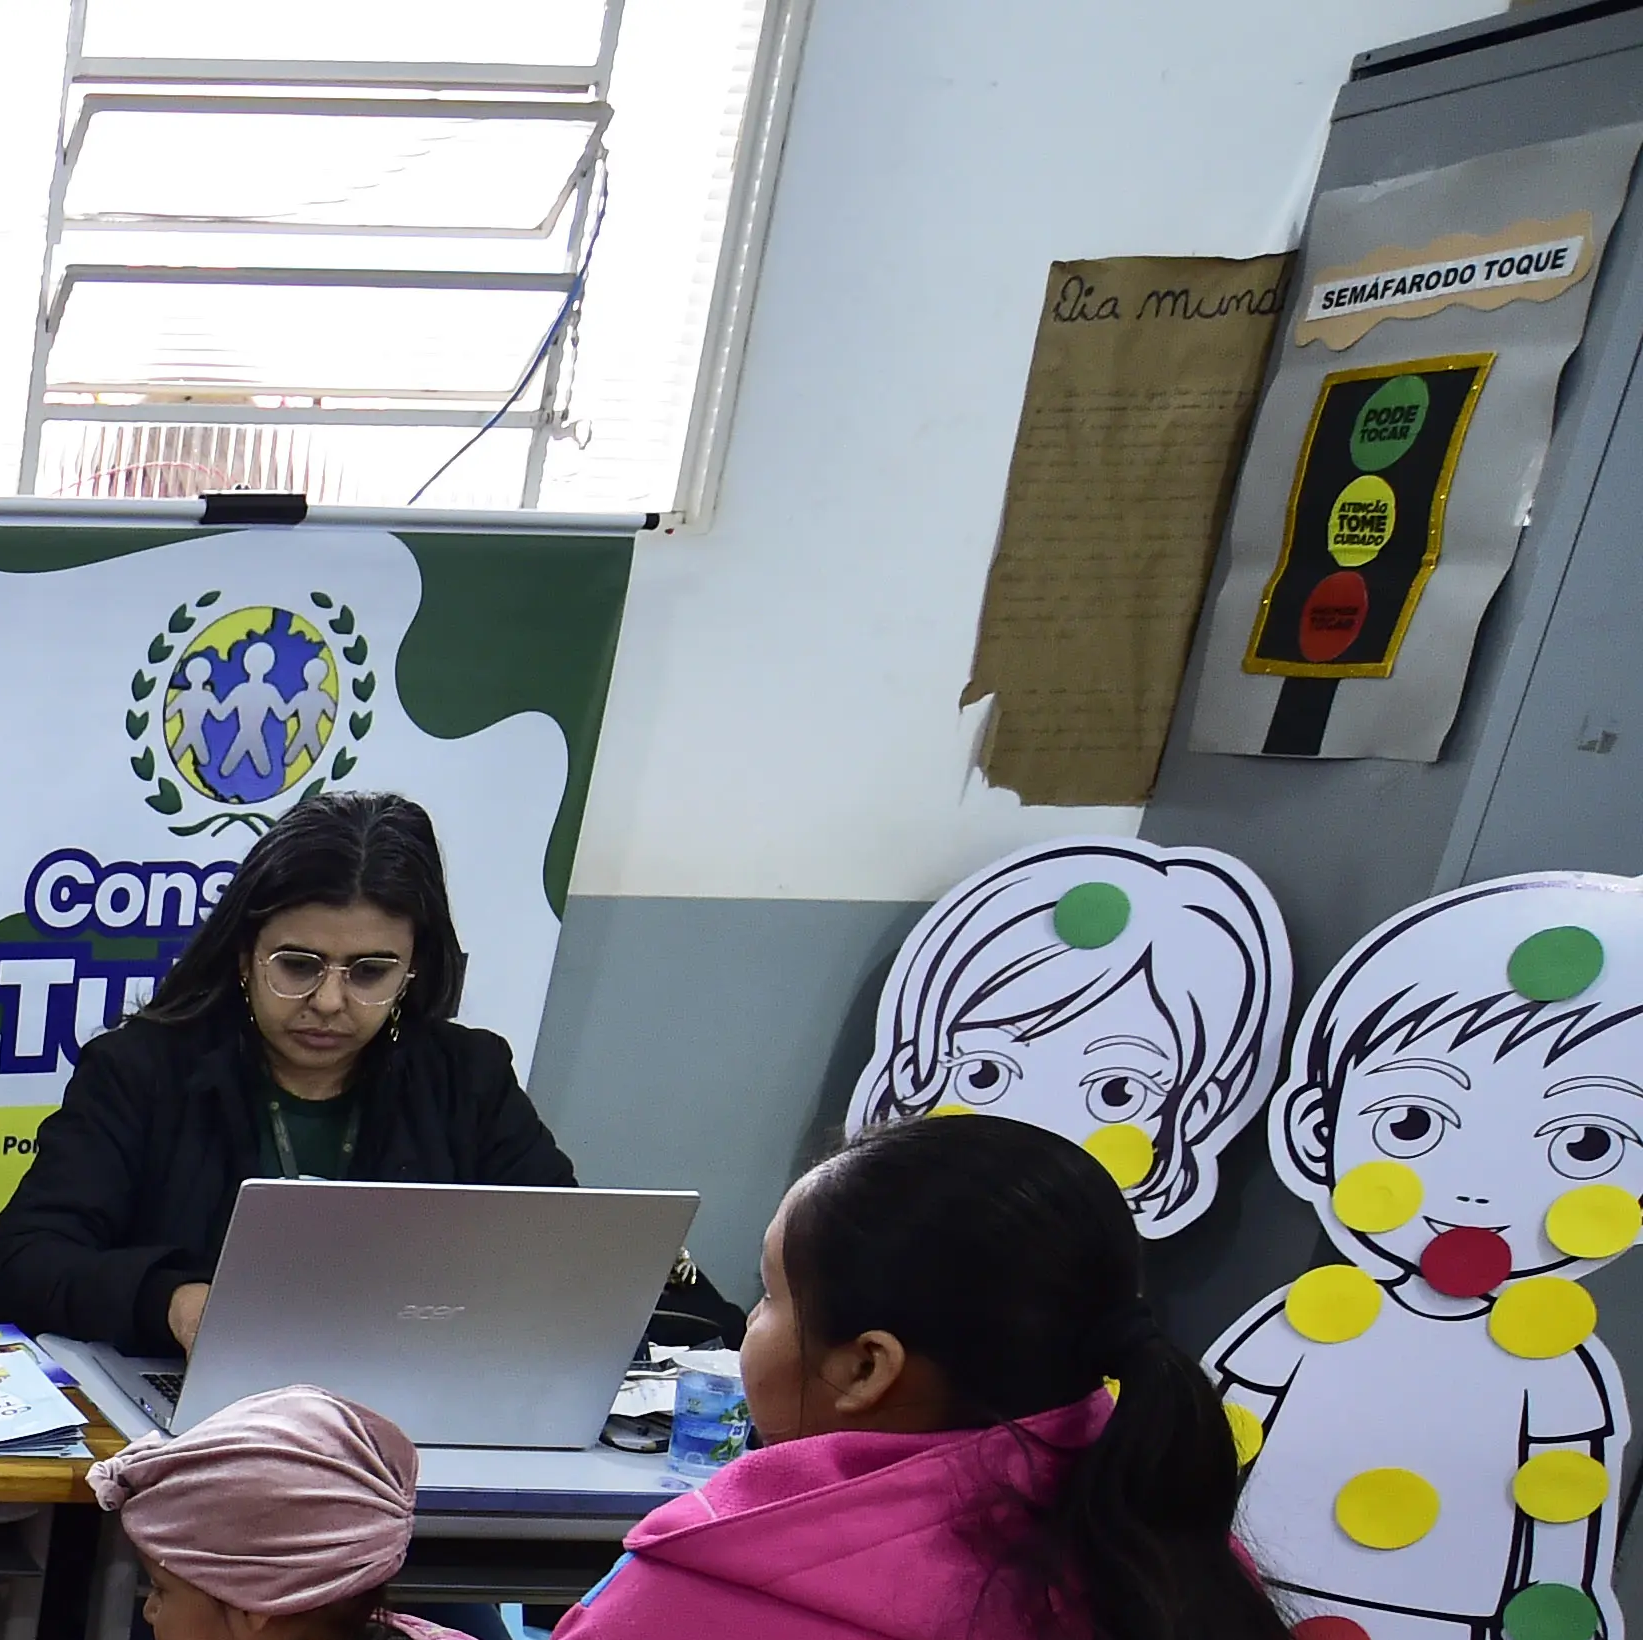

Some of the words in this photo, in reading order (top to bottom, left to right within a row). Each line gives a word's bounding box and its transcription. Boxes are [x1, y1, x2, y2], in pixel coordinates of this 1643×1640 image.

[1483, 247, 1570, 281] TOQUE
[1052, 274, 1120, 322] Dia
[1363, 404, 1419, 427] PODE
[1359, 425, 1411, 444] TOCAR
[1338, 499, 1389, 514] ATENÇÃO
[1337, 514, 1388, 534] TOME
[1333, 533, 1385, 546] CUIDADO
[397, 1304, 466, 1320] acer
